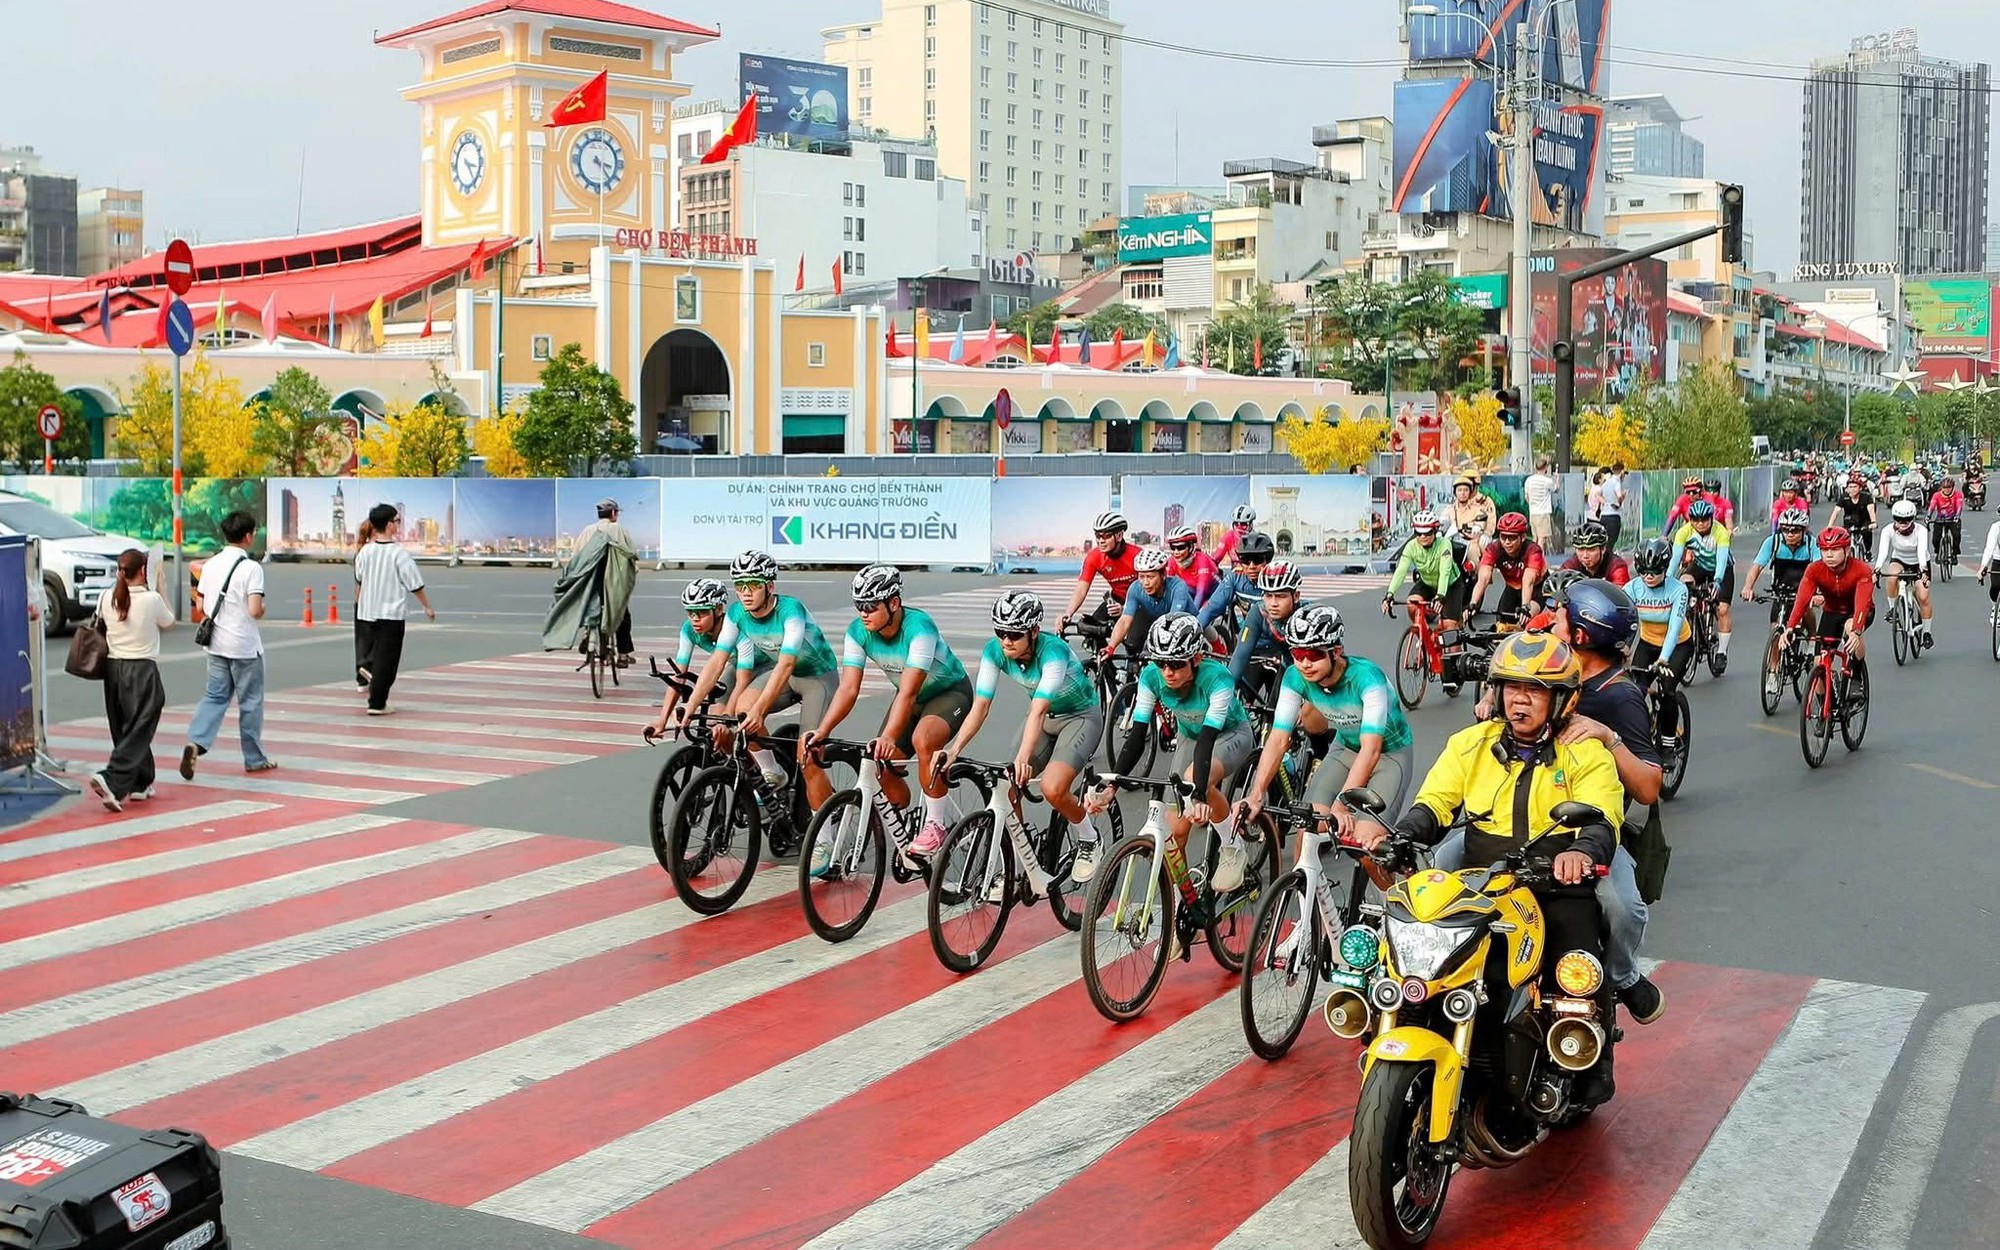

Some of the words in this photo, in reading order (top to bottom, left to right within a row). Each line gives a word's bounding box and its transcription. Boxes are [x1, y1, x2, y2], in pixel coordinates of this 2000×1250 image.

[616, 228, 652, 250] CHỢ
[658, 228, 691, 250] BẾN
[697, 232, 757, 256] THÀNH
[1794, 263, 1832, 277] KING
[1835, 261, 1899, 276] LUXURY
[1004, 422, 1027, 444] Vikki
[1155, 427, 1173, 445] Vikki
[728, 484, 745, 496] DỰ
[748, 482, 766, 494] ÁN:
[768, 481, 804, 494] CHỈNH
[807, 484, 847, 494] TRANG
[850, 484, 876, 496] CHỢ
[880, 481, 902, 493] BẾN
[904, 481, 943, 493] THÀNH
[770, 496, 785, 507] VÀ
[787, 498, 810, 507] KHU
[813, 498, 837, 509] VỰC
[839, 496, 879, 509] QUẢNG
[881, 496, 928, 507] TRƯỜNG
[693, 514, 721, 524] ĐƠN
[723, 515, 731, 526] VỊ
[731, 513, 744, 524] TÀI
[745, 515, 764, 526] TRỢ
[811, 522, 895, 540] KHANG
[900, 511, 957, 540] ĐIỀN
[873, 790, 910, 850] FACTOR
[1008, 810, 1038, 873] FACTOR
